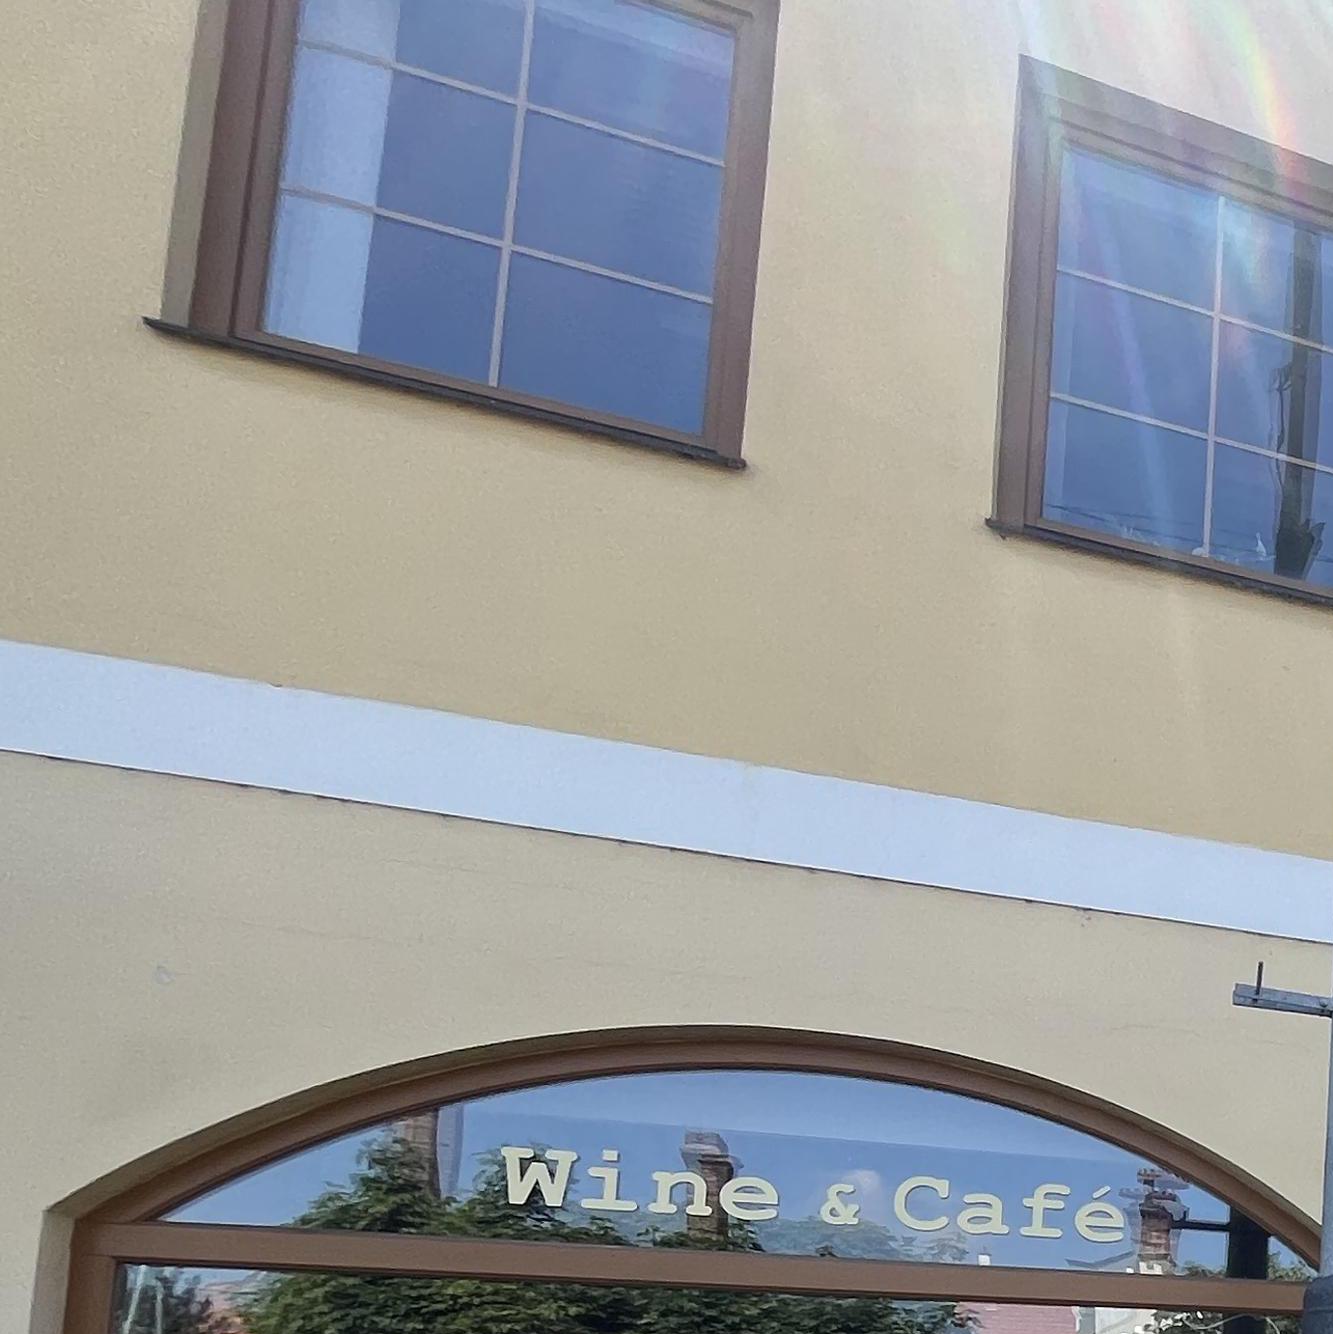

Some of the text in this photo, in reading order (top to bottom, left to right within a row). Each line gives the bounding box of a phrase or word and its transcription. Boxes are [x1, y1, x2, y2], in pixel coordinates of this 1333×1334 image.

[501, 1146, 1126, 1243] Wine & Café
